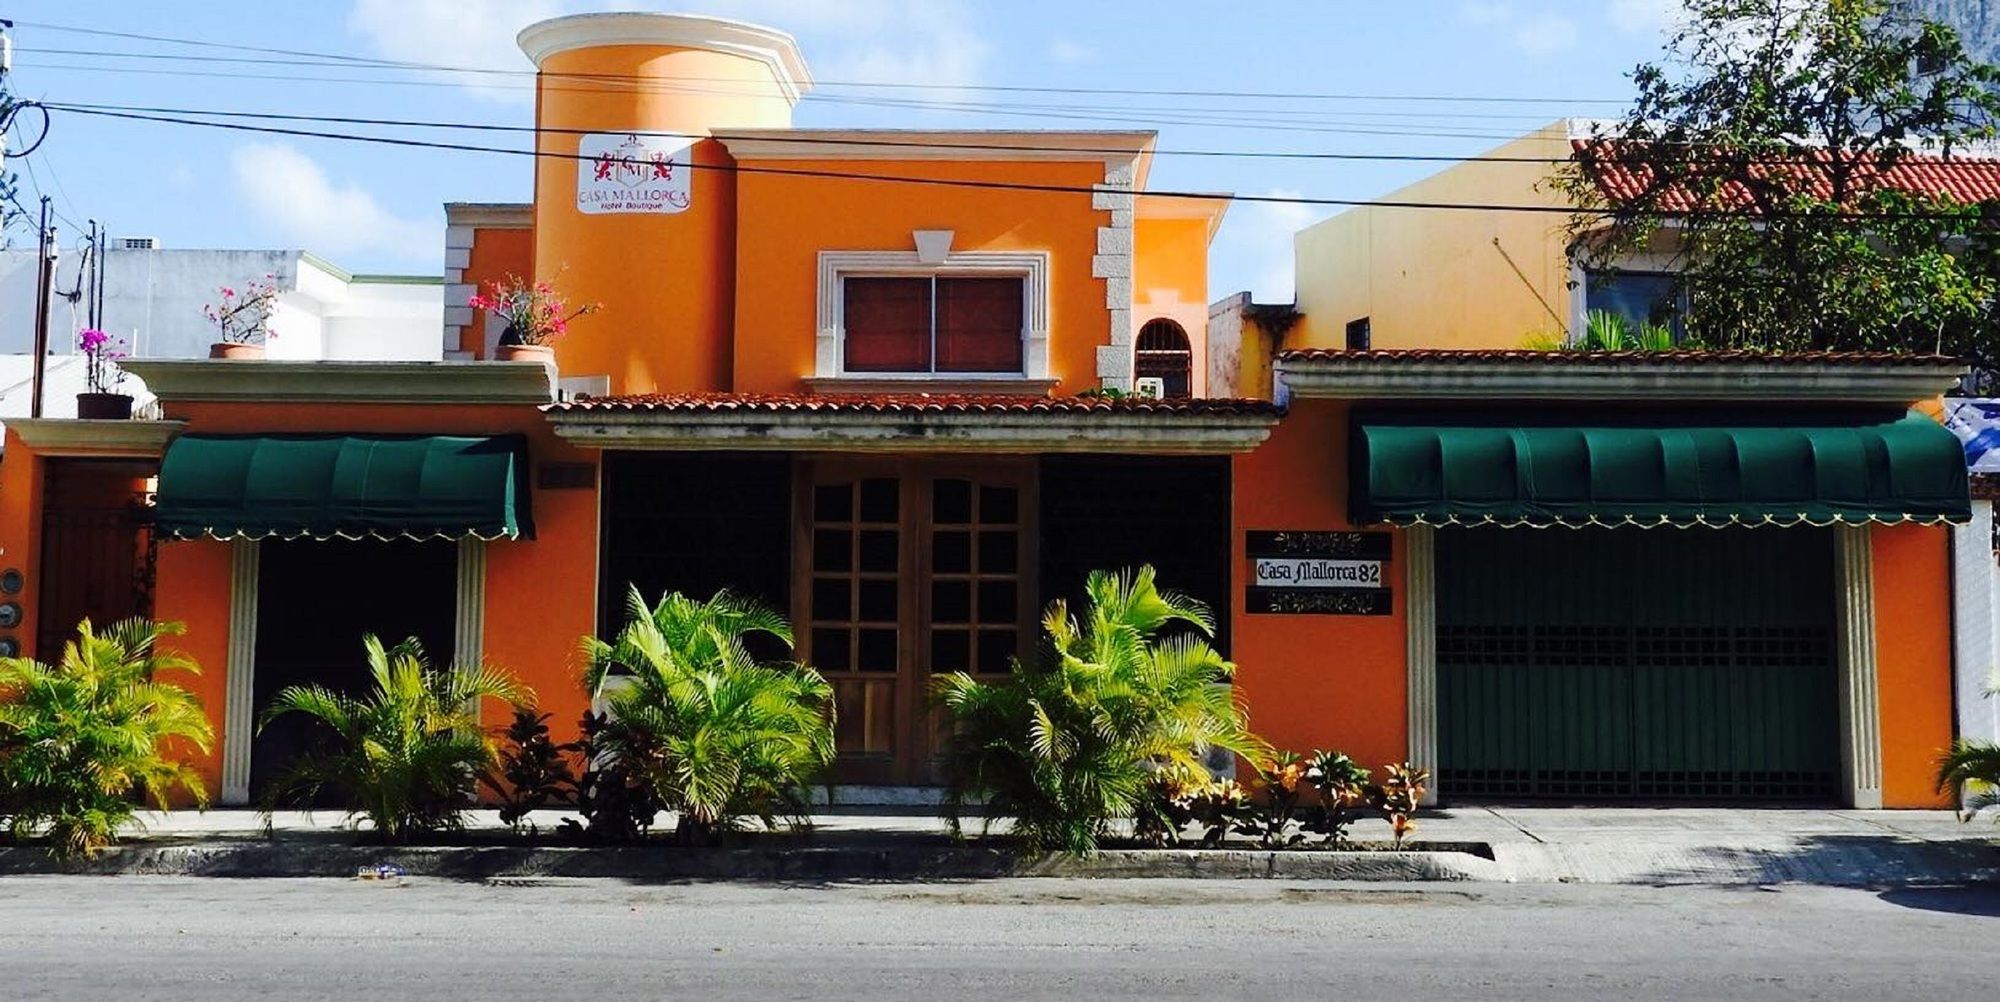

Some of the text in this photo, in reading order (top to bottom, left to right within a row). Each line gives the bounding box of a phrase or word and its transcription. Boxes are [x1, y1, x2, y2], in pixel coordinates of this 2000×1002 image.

[579, 189, 689, 204] CASA MALLORCA
[626, 202, 663, 210] Boutique
[1258, 561, 1379, 583] Casa Mallorca 82
